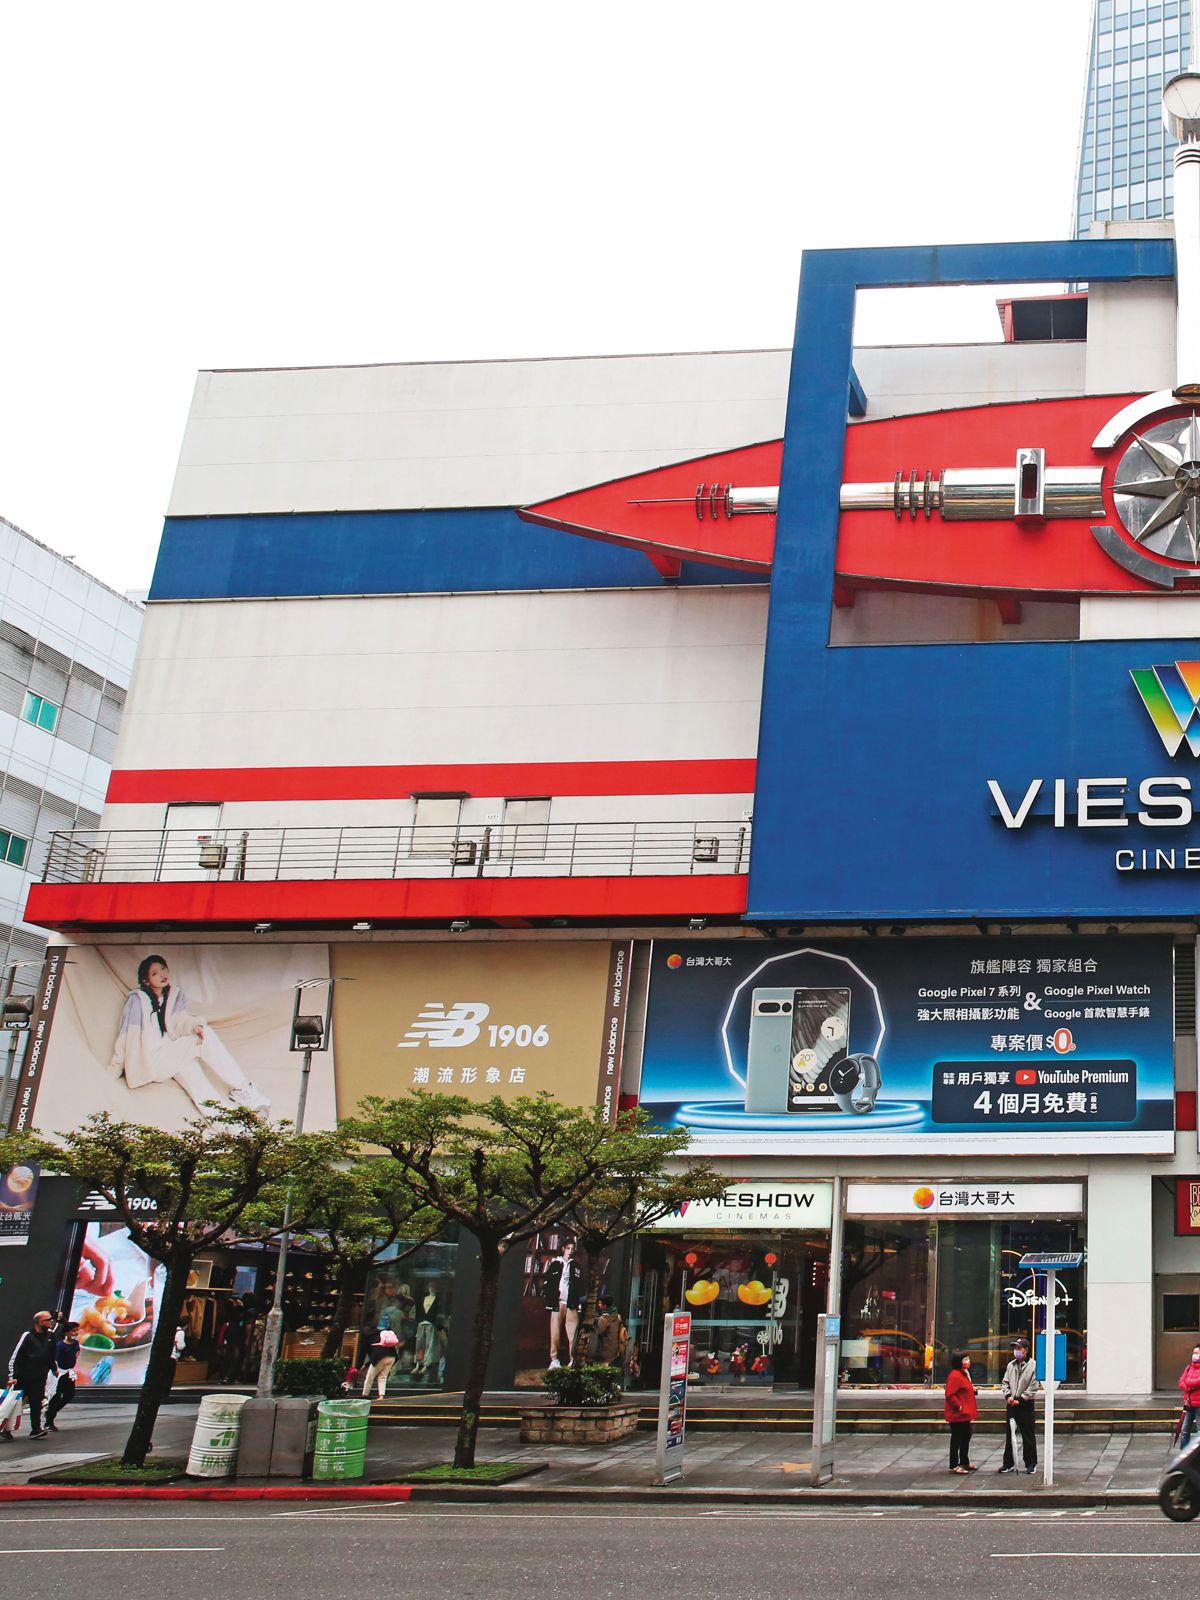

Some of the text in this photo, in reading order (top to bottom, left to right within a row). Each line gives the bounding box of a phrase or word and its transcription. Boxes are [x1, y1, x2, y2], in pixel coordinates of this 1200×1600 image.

[613, 950, 624, 989] balance
[686, 956, 732, 967] 台灣大哥大
[970, 958, 1098, 974] 旗艦陣容 獨家組合
[42, 974, 57, 1011] balance
[918, 985, 1021, 999] Google Pixel 7 系列
[1044, 985, 1151, 998] Google Pixel Watch
[1023, 991, 1042, 1011] &
[917, 1007, 1020, 1021] 強大照相攝影功能
[1044, 1007, 1150, 1020] Google 首款智慧手錶
[488, 1024, 550, 1048] 1906
[990, 1034, 1043, 1052] 專案價
[28, 1020, 46, 1077] new balance
[607, 1017, 618, 1075] new balance
[413, 1066, 526, 1084] 潮流形象店
[957, 1070, 1128, 1085] 用戶獨享 YouTube Premium
[21, 1087, 31, 1105] new
[973, 1091, 1087, 1114] 4 個月免費
[939, 1190, 1015, 1206] 台灣大哥大
[716, 1212, 791, 1220] CINEMAS
